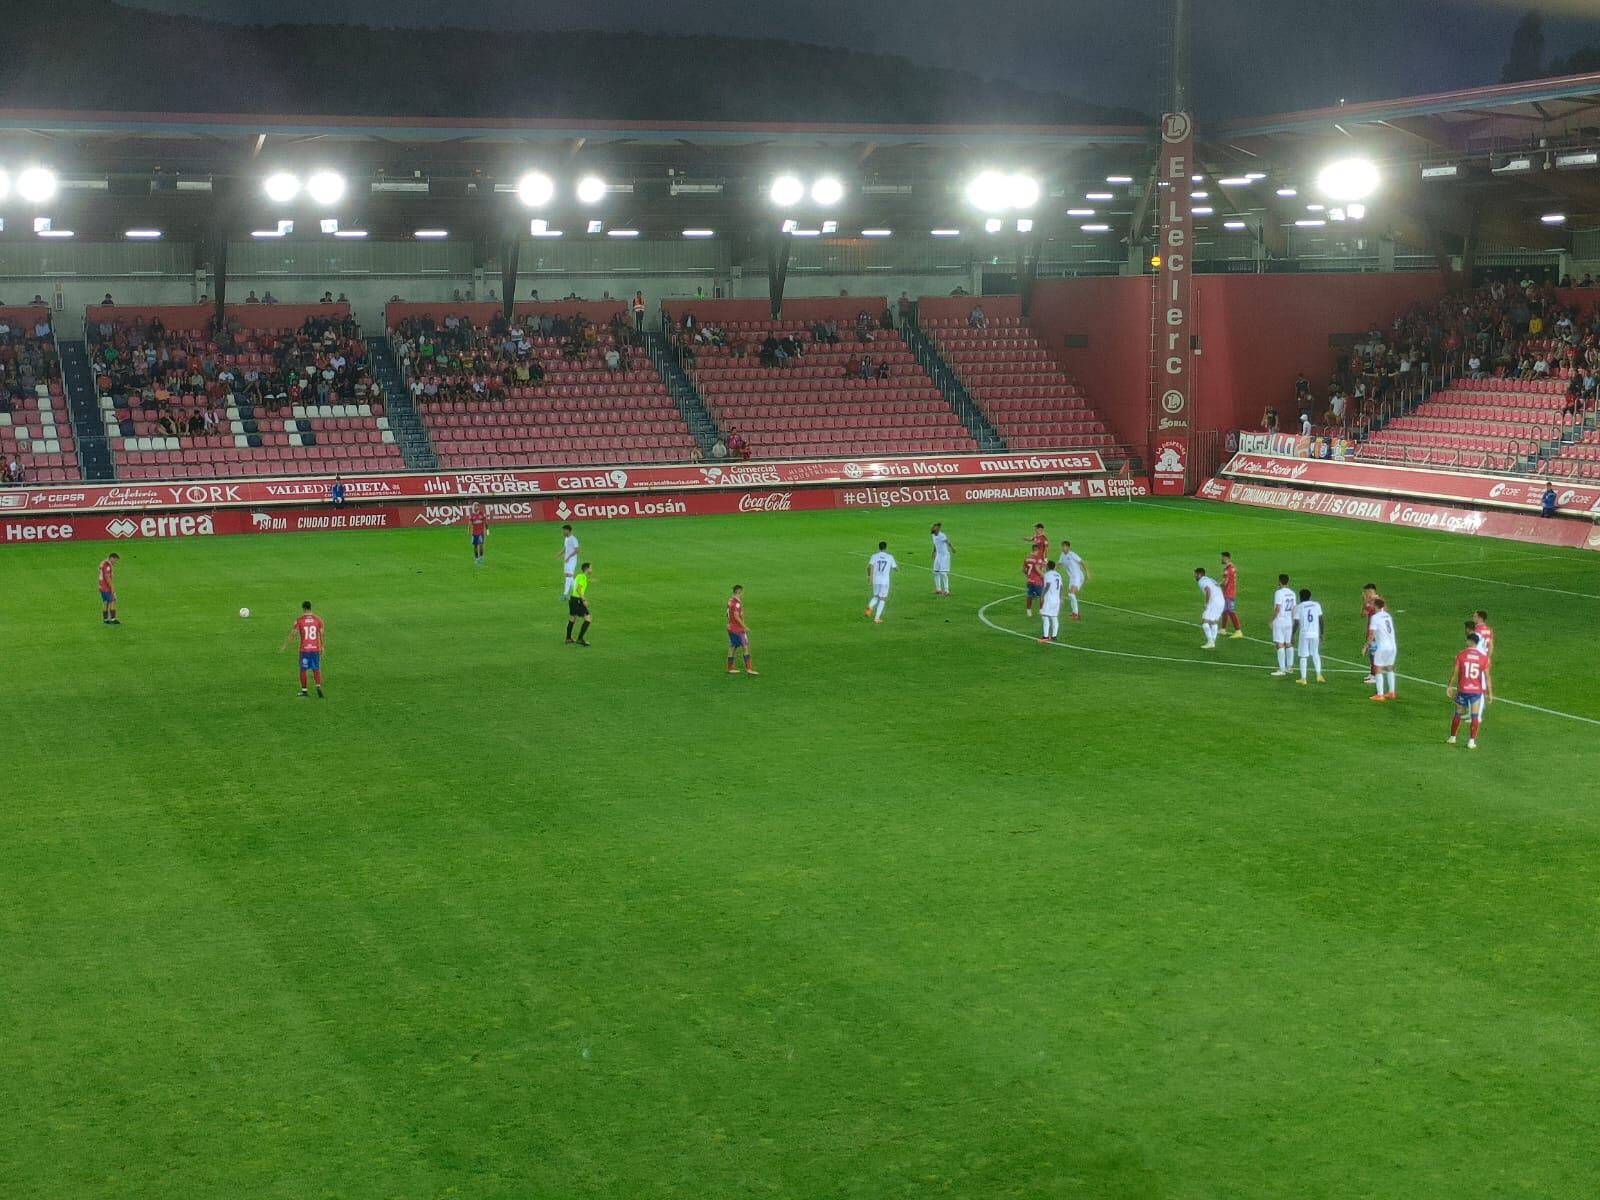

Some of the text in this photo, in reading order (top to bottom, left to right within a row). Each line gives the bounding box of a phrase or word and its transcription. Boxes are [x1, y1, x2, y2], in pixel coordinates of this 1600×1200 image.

[730, 464, 777, 474] Comercial
[912, 461, 960, 474] Motor
[455, 473, 519, 484] HOSPITAL
[168, 485, 242, 503] YORK
[456, 480, 541, 495] LATORRE
[964, 486, 1065, 500] COMPRALAENTRADA
[48, 493, 85, 502] CEPSA
[738, 492, 793, 512] Coca-Cola
[843, 485, 951, 507] #eligeSoria
[426, 502, 532, 518] MONT PINOS
[573, 498, 687, 519] Grupo Losán
[297, 514, 387, 528] CIUDAD DEL DEPORTE
[6, 524, 73, 540] Herce
[877, 560, 888, 573] 17
[1306, 609, 1314, 623] 6
[303, 625, 317, 640] 18
[1463, 662, 1479, 679] 15
